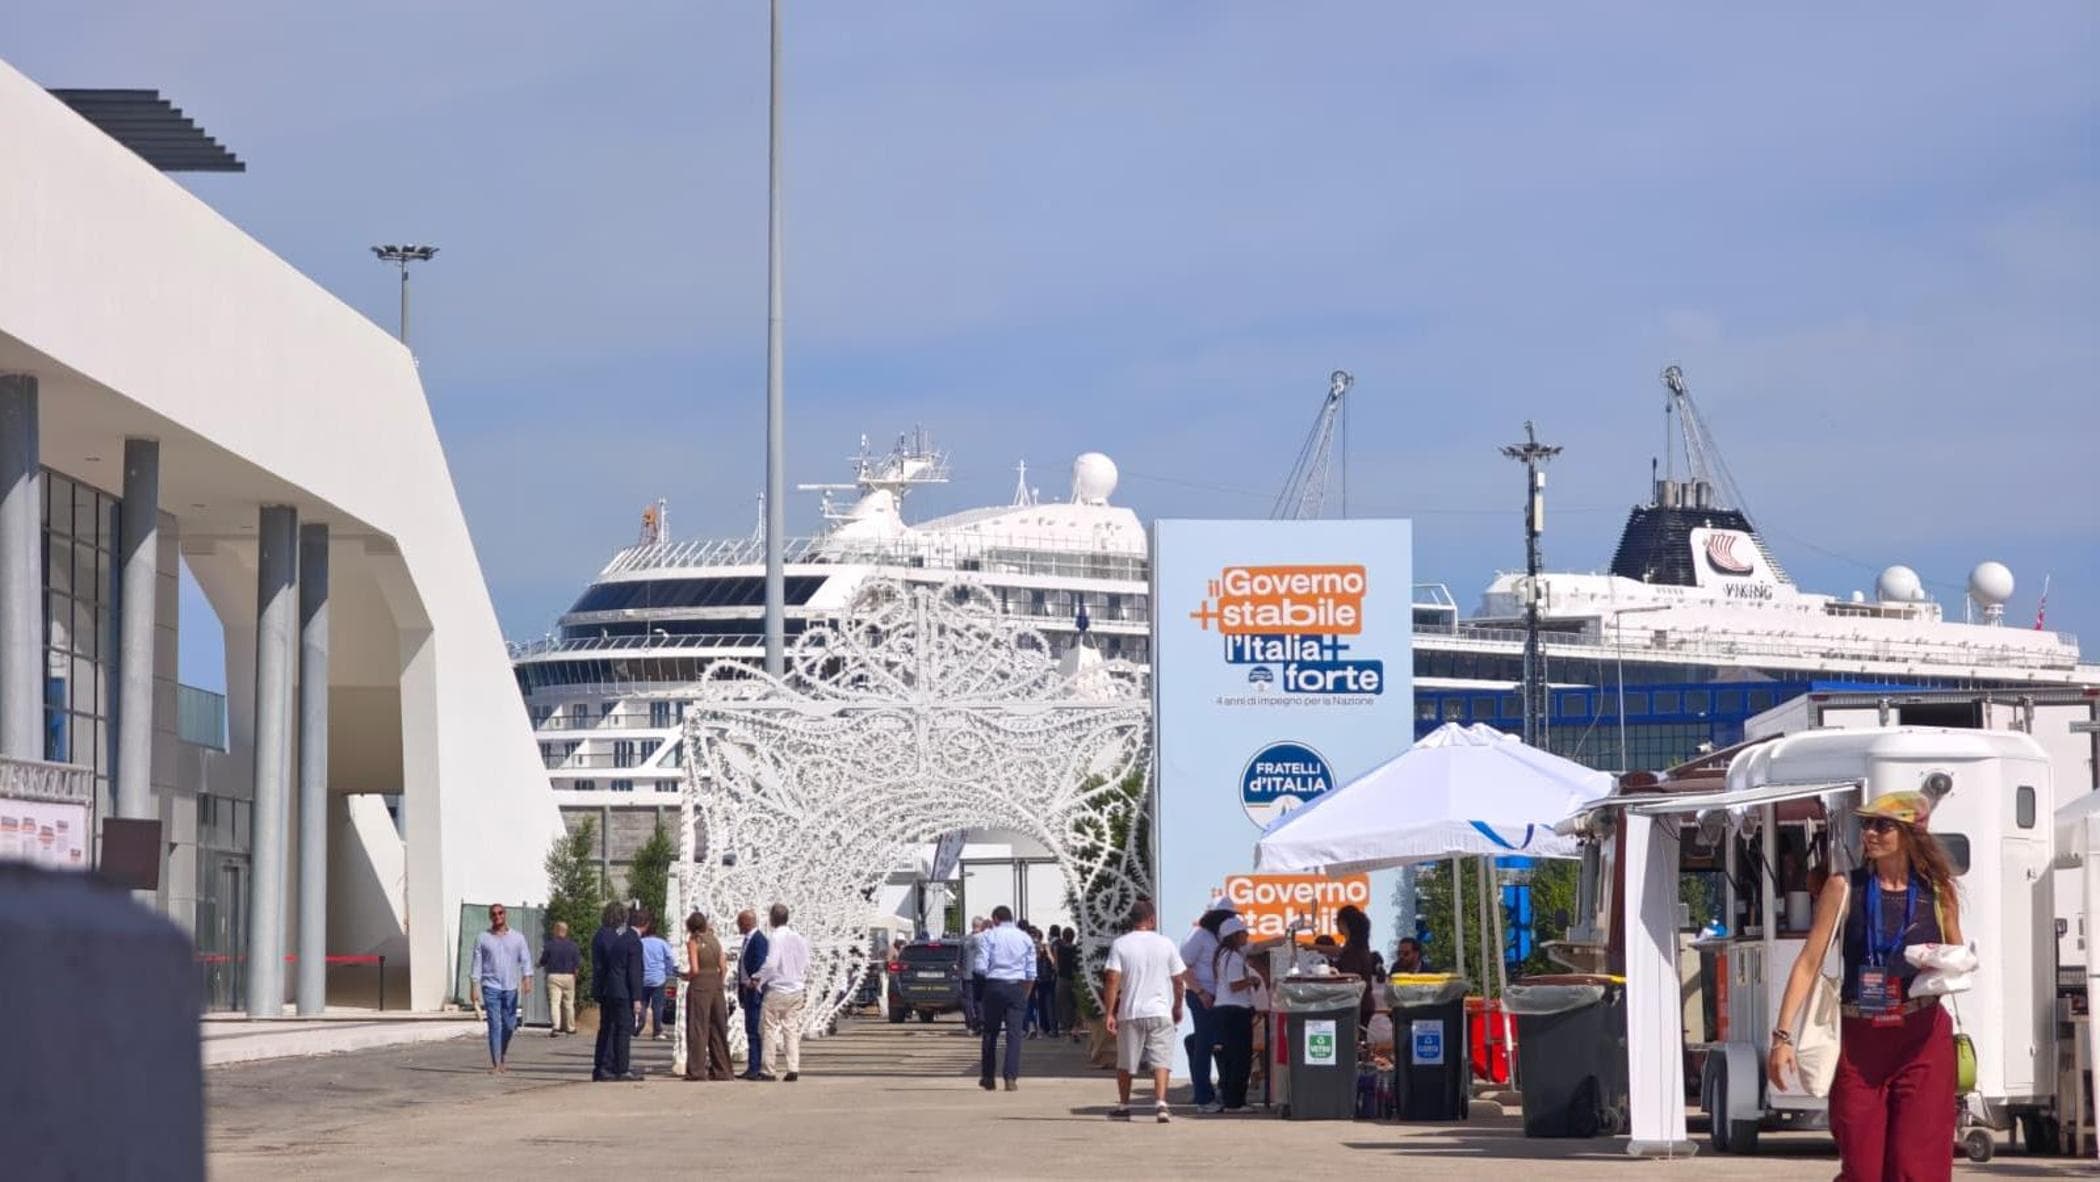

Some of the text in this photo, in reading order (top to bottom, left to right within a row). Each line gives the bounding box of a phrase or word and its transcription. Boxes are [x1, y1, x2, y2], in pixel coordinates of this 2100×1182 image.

[1224, 569, 1364, 597] Governo
[1724, 583, 1773, 600] VIKING
[1285, 663, 1379, 691] forte
[1224, 696, 1247, 706] anni
[1247, 695, 1257, 706] di
[1258, 695, 1302, 709] impegno
[1304, 697, 1321, 709] per
[1322, 695, 1332, 706] la
[1332, 695, 1375, 706] Nazione
[1256, 762, 1321, 775] FRATELLI
[1249, 776, 1327, 793] d'ITALIA
[1227, 877, 1368, 905] Governo
